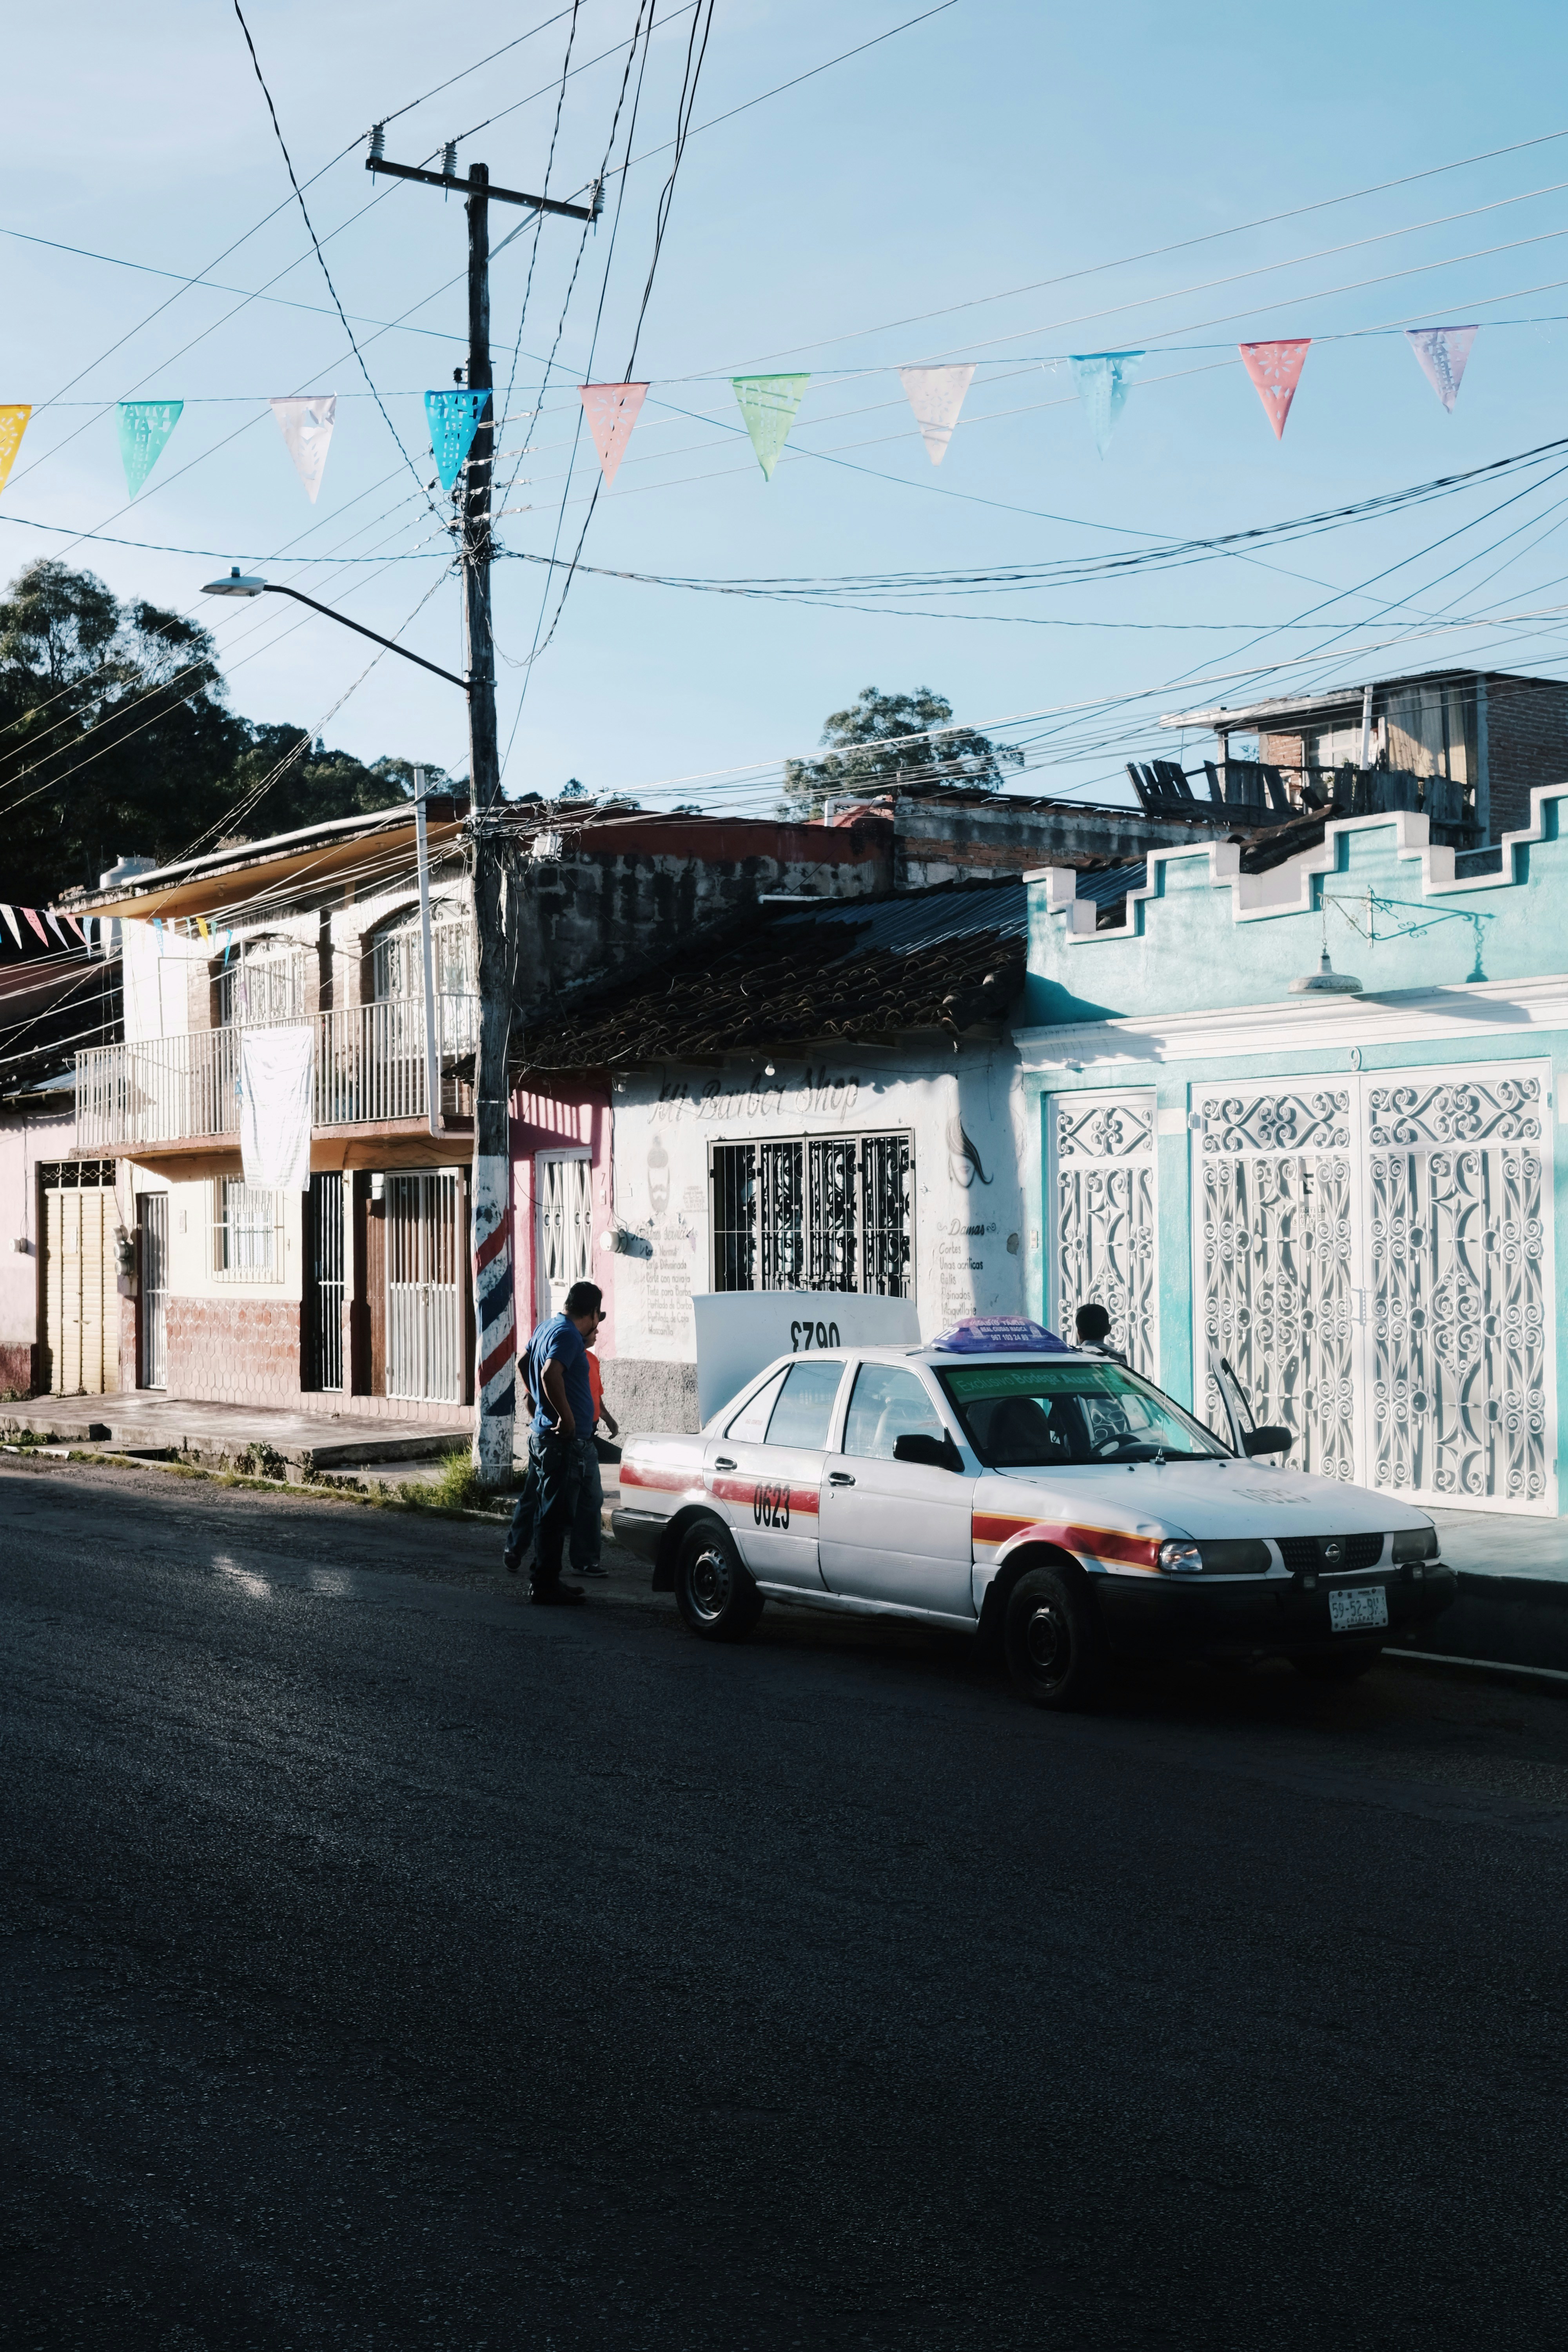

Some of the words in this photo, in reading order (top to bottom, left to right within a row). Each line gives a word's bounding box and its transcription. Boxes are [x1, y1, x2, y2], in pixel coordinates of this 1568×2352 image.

[1348, 1047, 1360, 1071] 9
[695, 1072, 786, 1120] Barber
[796, 1065, 859, 1123] Shop
[948, 1218, 984, 1236] Damas
[939, 1242, 961, 1254] Cortes
[957, 1256, 983, 1270] acrilicas
[646, 1272, 659, 1283] Corte
[672, 1273, 690, 1287] navaja
[647, 1285, 659, 1296] Tinte
[661, 1289, 673, 1298] para
[675, 1285, 691, 1296] Barba
[942, 1287, 971, 1300] Peinados
[647, 1298, 668, 1309] Perfilado
[670, 1299, 675, 1309] de
[677, 1299, 692, 1310] Barba
[942, 1302, 976, 1319] Maquillaje
[648, 1324, 673, 1336] Mascarilla
[956, 1376, 1014, 1391] Exclusivo
[1010, 1373, 1060, 1385] Bodega
[1232, 1488, 1311, 1504] 0623
[754, 1480, 790, 1529] 0623
